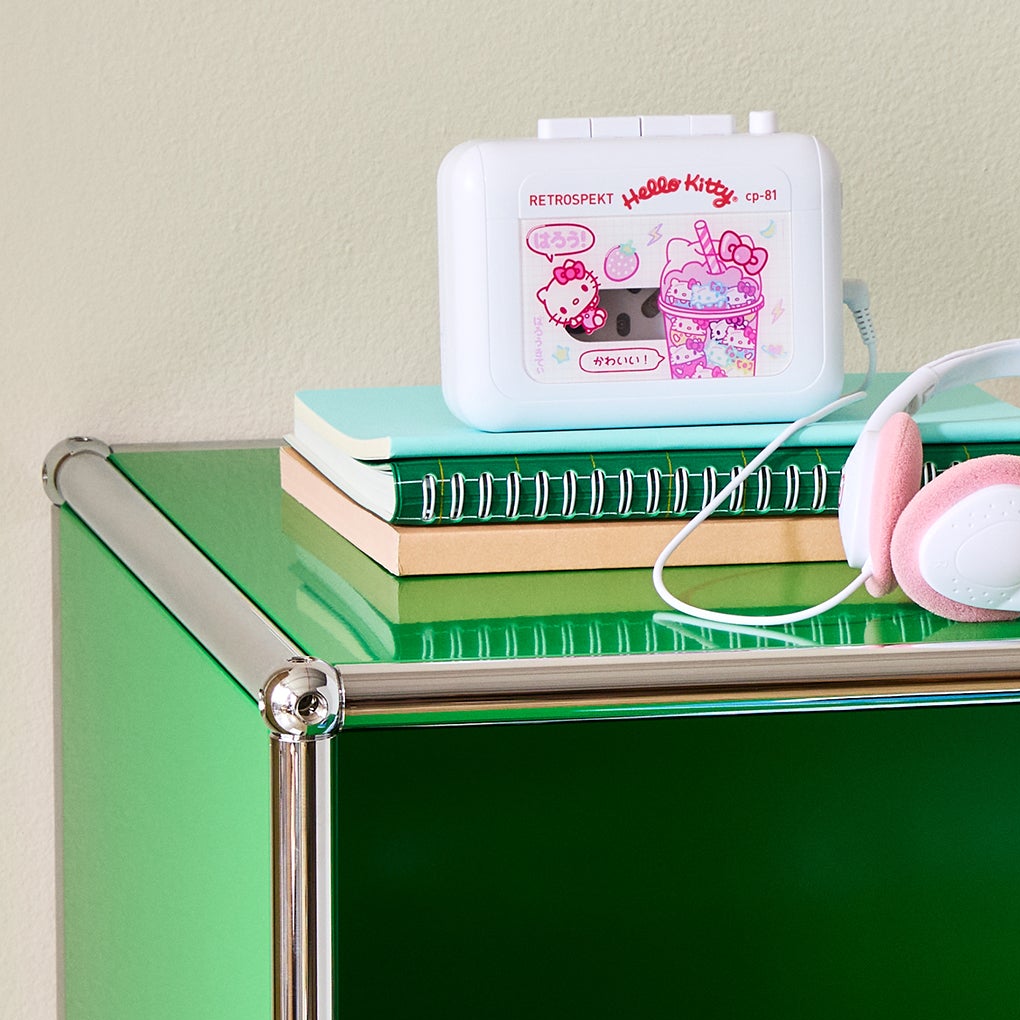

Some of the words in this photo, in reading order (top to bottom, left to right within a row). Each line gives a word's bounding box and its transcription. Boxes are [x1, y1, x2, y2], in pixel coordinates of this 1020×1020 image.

[529, 193, 614, 206] RETROSPEKT
[621, 175, 681, 210] Hello
[745, 189, 777, 203] cp-81
